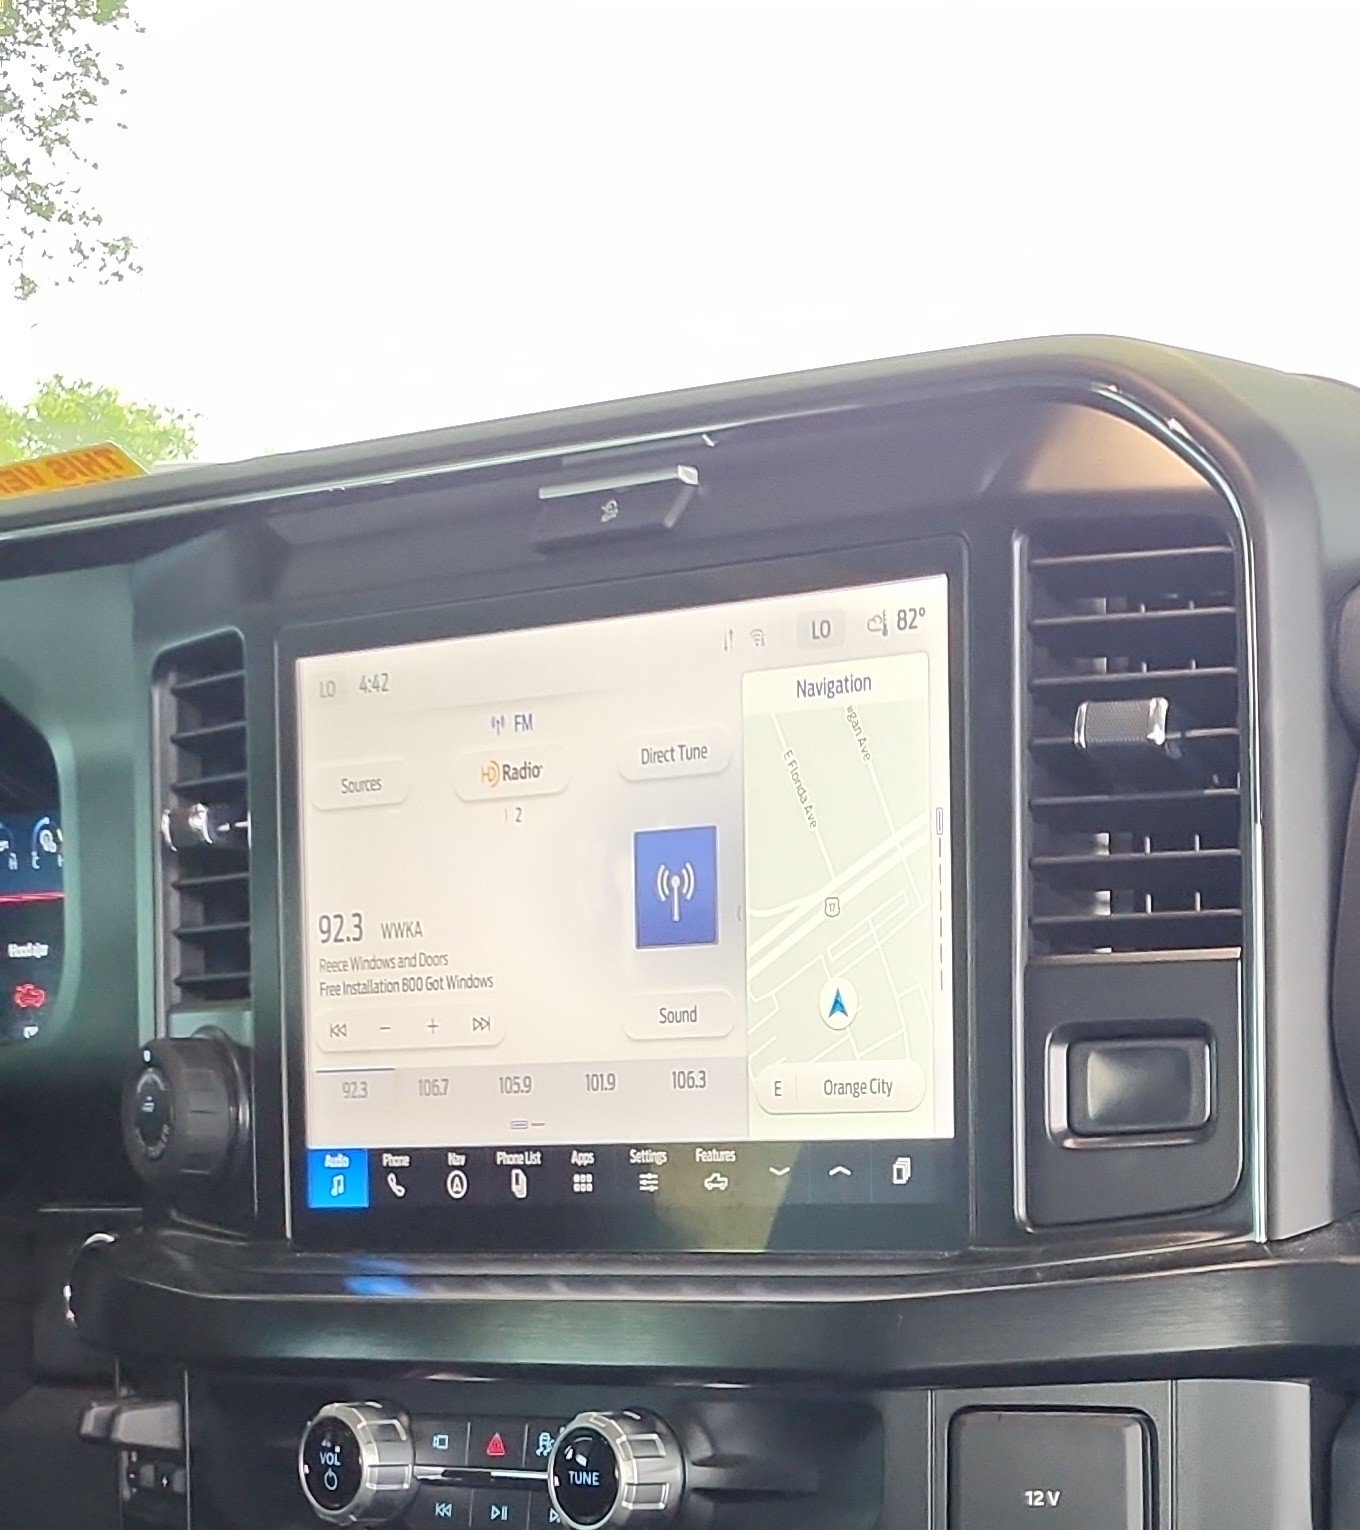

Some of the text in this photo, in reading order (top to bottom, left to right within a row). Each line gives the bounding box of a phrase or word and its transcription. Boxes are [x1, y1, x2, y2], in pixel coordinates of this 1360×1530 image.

[811, 619, 832, 640] LO
[319, 681, 337, 699] LO
[358, 672, 390, 694] 4:42
[795, 673, 873, 700] Navigation
[514, 713, 534, 732] FM
[641, 744, 709, 766] Direct Tune
[502, 761, 541, 782] Radio
[341, 777, 383, 795] Sources
[514, 806, 524, 823] 2
[318, 911, 424, 944] 92.3 WWKA
[319, 951, 449, 973] Reece Windows and Doors
[319, 981, 342, 997] Free
[342, 977, 400, 995] Installation
[425, 975, 445, 992] Got
[446, 973, 494, 990] Windows
[659, 1005, 698, 1025] Sound
[417, 1078, 450, 1097] 106.7
[498, 1075, 533, 1095] 105.9
[584, 1072, 617, 1092] 101.9
[671, 1069, 707, 1090] 106.3
[773, 1081, 783, 1097] E
[823, 1075, 894, 1099] Orange City
[341, 1080, 368, 1099] 92.3
[324, 1154, 350, 1168] Audio
[382, 1153, 410, 1167] Phone
[447, 1152, 466, 1166] Nav
[496, 1151, 542, 1166] Phone List
[570, 1150, 595, 1166] Apps
[629, 1148, 668, 1165] Settings
[695, 1147, 736, 1162] Features
[320, 1451, 341, 1466] VOL
[568, 1470, 600, 1486] TUNE
[1026, 1491, 1060, 1507] 12 V
